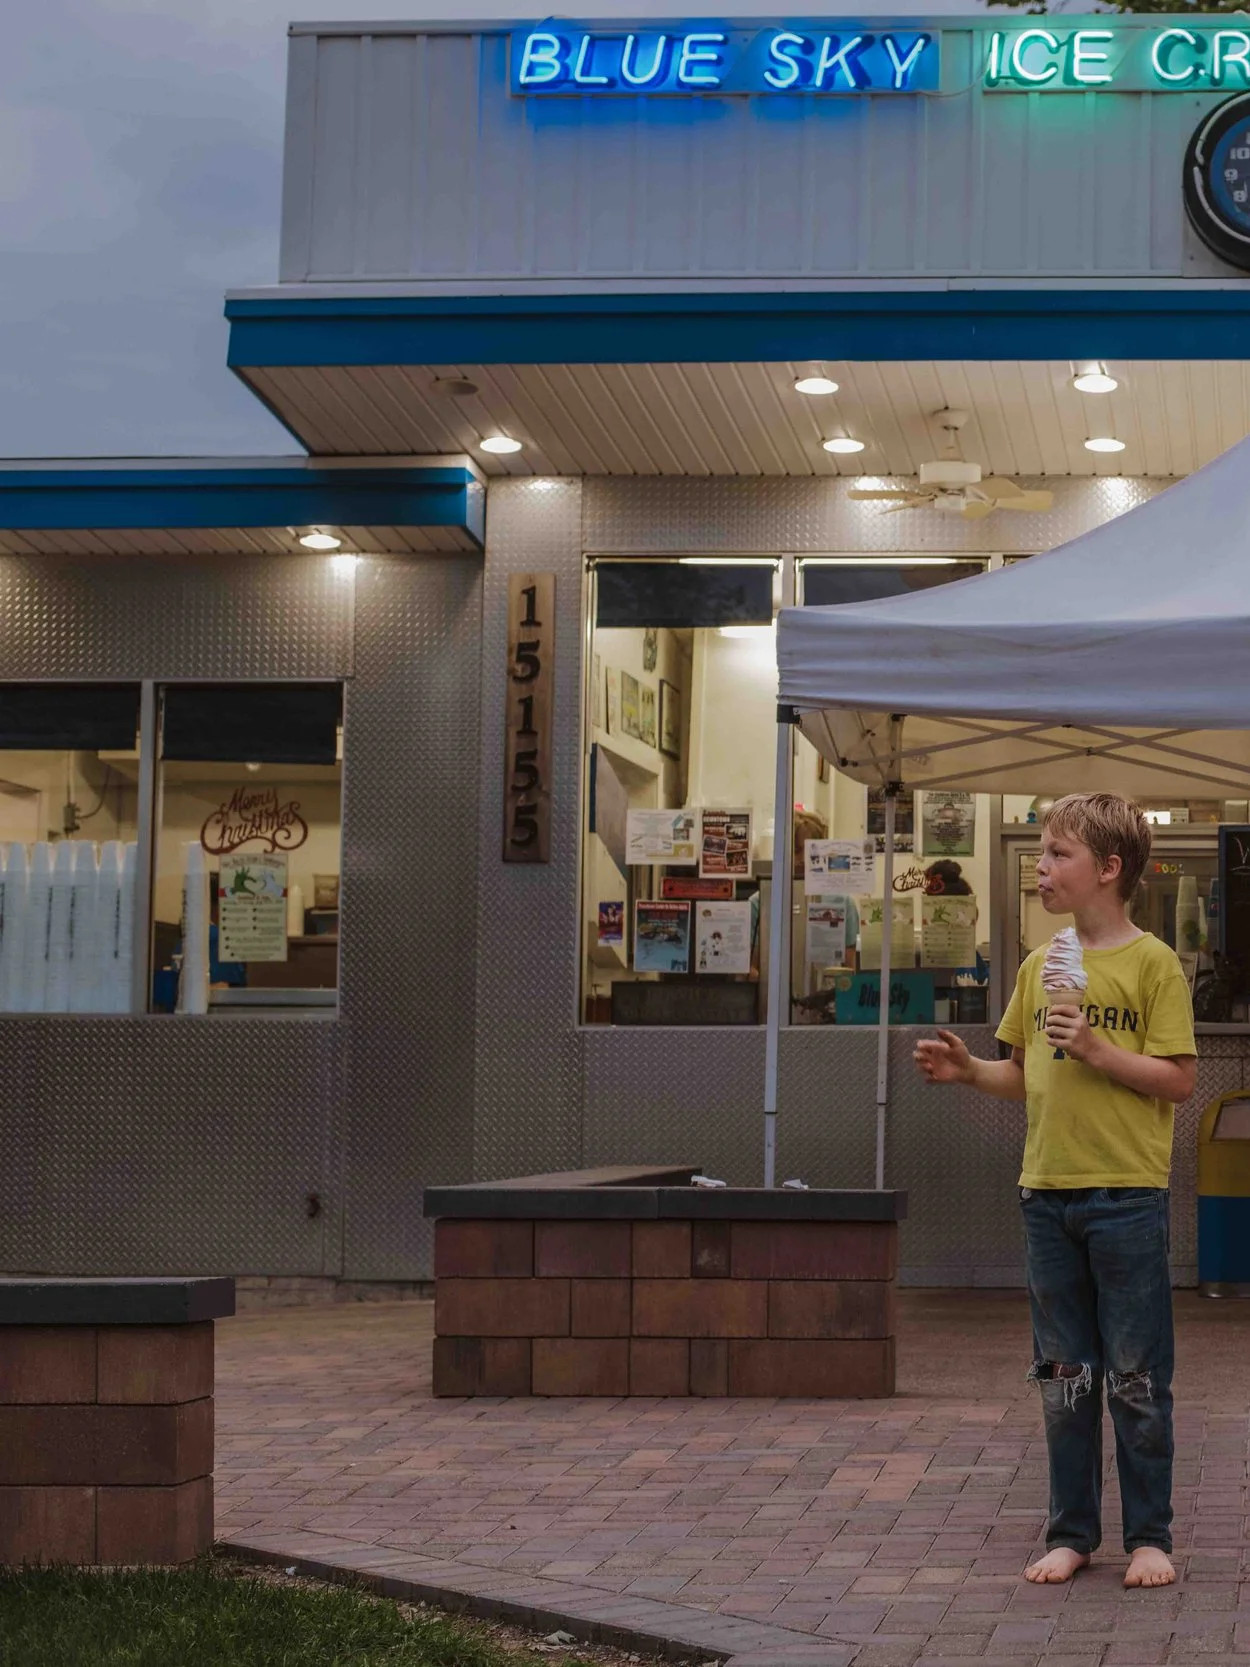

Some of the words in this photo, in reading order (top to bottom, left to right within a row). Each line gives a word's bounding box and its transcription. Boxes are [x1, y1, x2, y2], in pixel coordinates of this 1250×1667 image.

[519, 33, 725, 85] BLUE
[763, 33, 931, 89] SKY
[989, 28, 1114, 85] ICE
[1230, 147, 1250, 160] 10
[1224, 168, 1238, 183] 9
[1233, 190, 1248, 203] 8
[858, 983, 881, 1008] Blu
[1034, 1004, 1139, 1033] MIGAN
